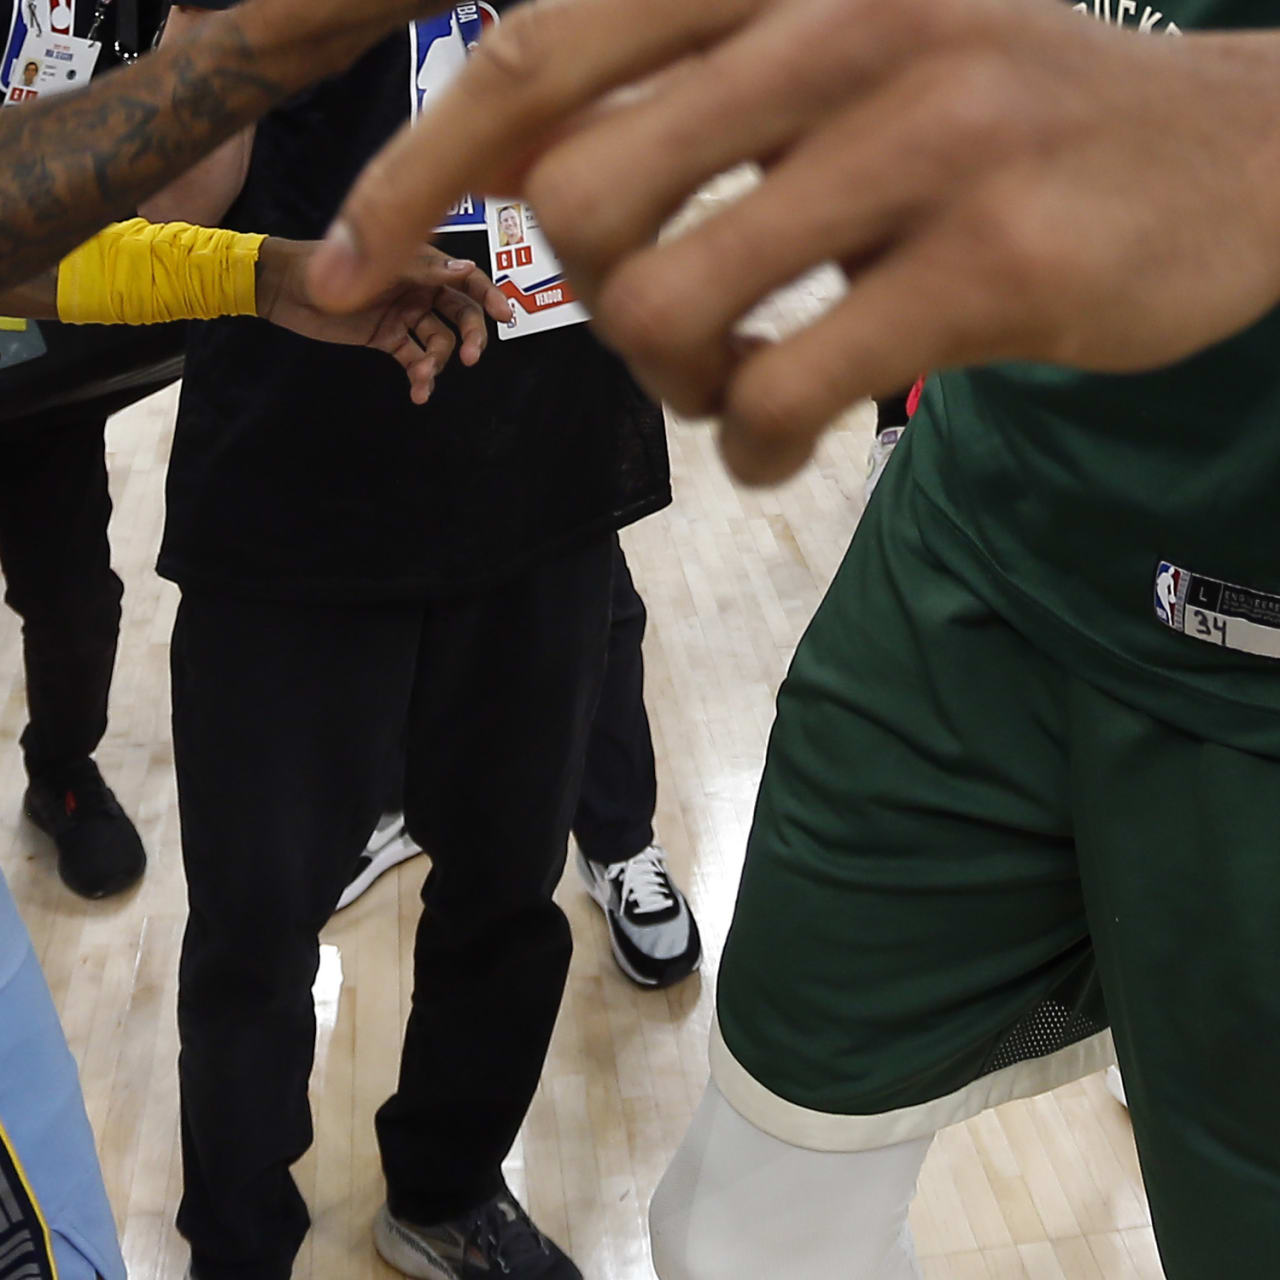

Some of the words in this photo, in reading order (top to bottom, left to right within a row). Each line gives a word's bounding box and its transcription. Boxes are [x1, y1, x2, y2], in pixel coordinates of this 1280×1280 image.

[534, 289, 563, 306] VENDOR
[1199, 586, 1207, 602] L
[1194, 609, 1226, 646] 34
